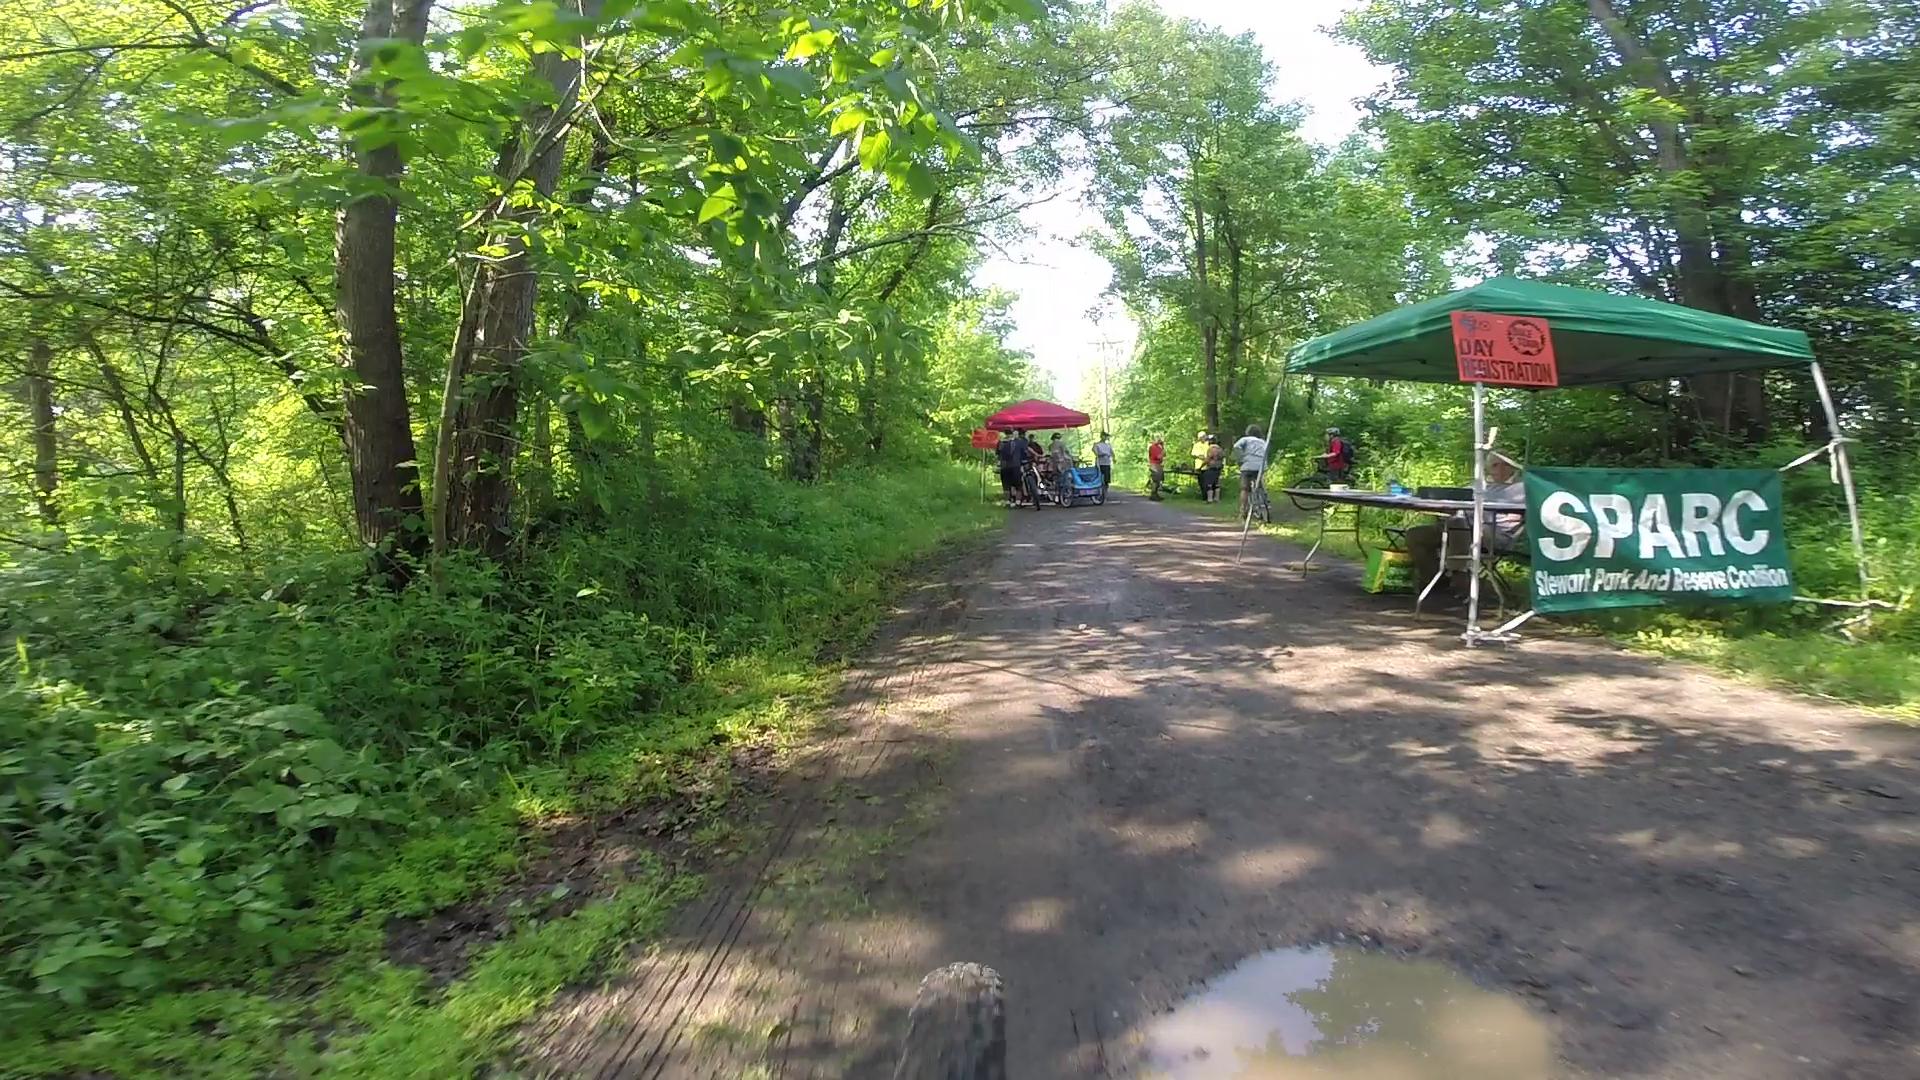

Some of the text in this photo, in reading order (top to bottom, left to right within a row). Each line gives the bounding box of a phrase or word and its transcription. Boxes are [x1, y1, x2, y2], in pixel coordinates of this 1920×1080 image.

[1458, 338, 1494, 357] DAY
[1460, 357, 1553, 383] REGISTRATION
[1538, 490, 1769, 561] SPARC
[1536, 568, 1591, 596] Stewart
[1593, 567, 1633, 592] Park
[1634, 568, 1670, 591] And
[1672, 567, 1728, 592] Reserve
